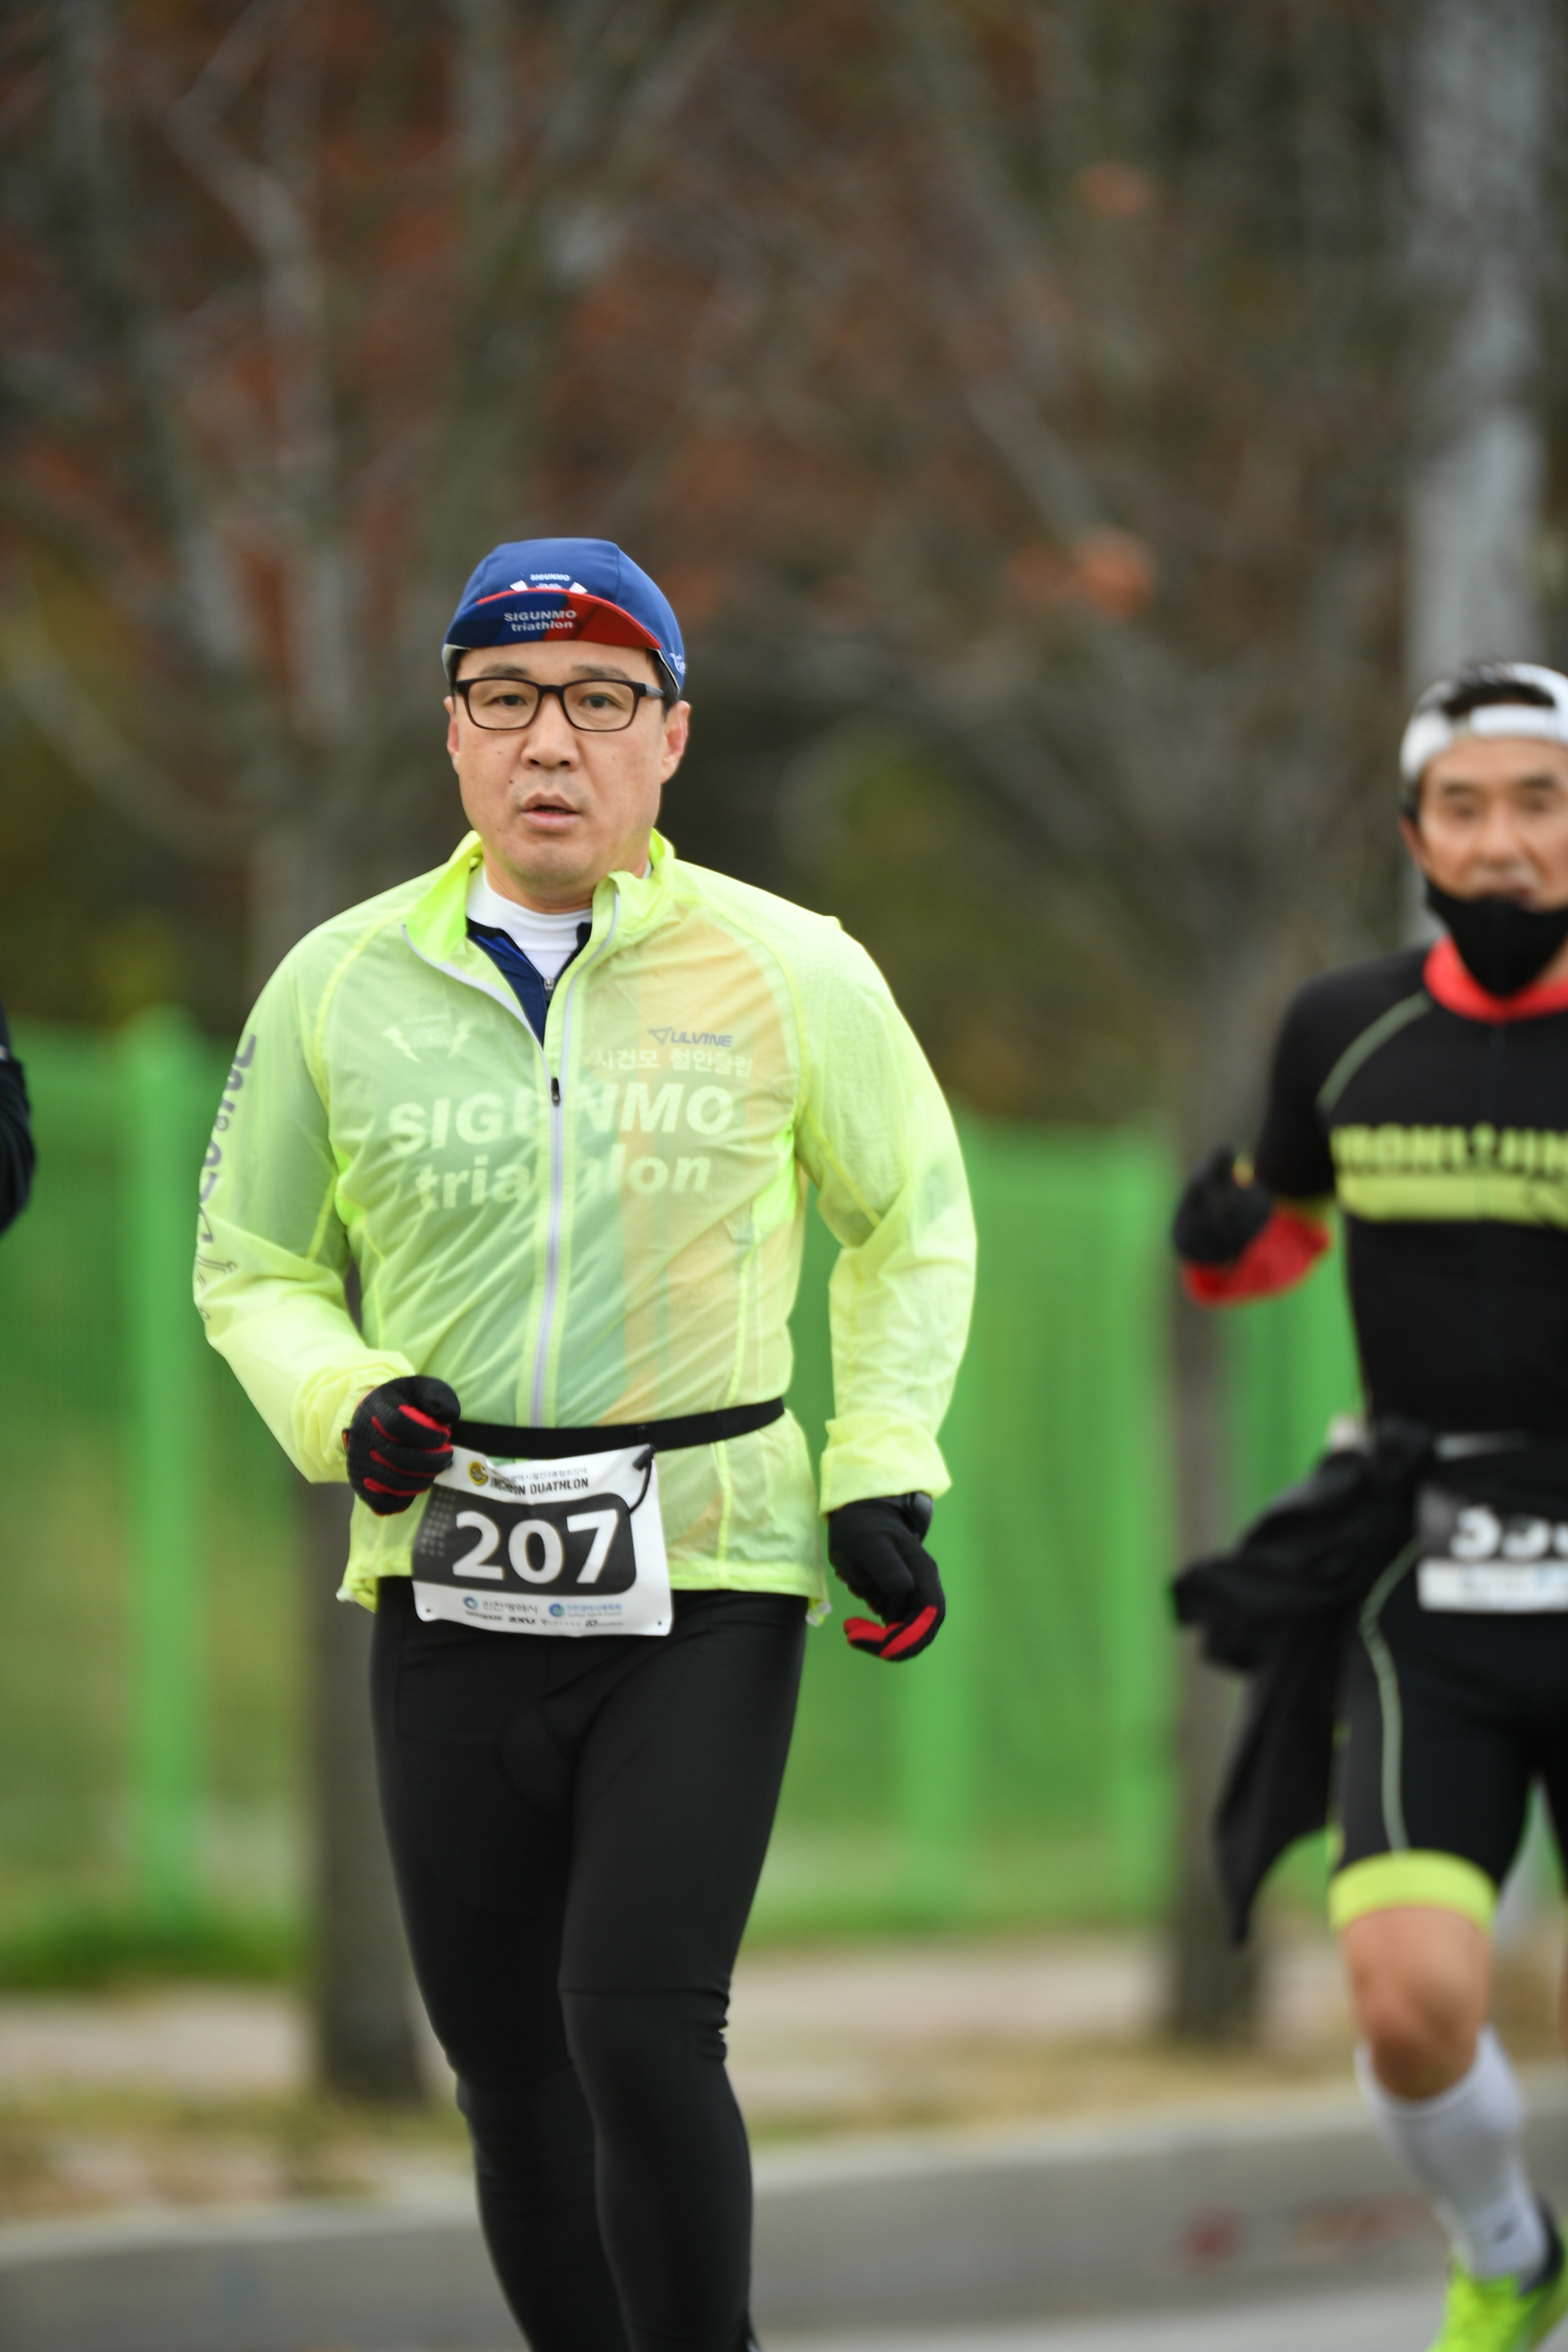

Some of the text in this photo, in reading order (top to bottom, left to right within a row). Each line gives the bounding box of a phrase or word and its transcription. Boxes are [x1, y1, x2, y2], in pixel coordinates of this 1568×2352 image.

[504, 610, 577, 622] SIGUNMO
[511, 620, 573, 631] triathlon
[595, 1049, 660, 1070] 시건모
[416, 1144, 710, 1210] trialon
[529, 1478, 589, 1494] DUATHLON
[452, 1509, 618, 1584] 207
